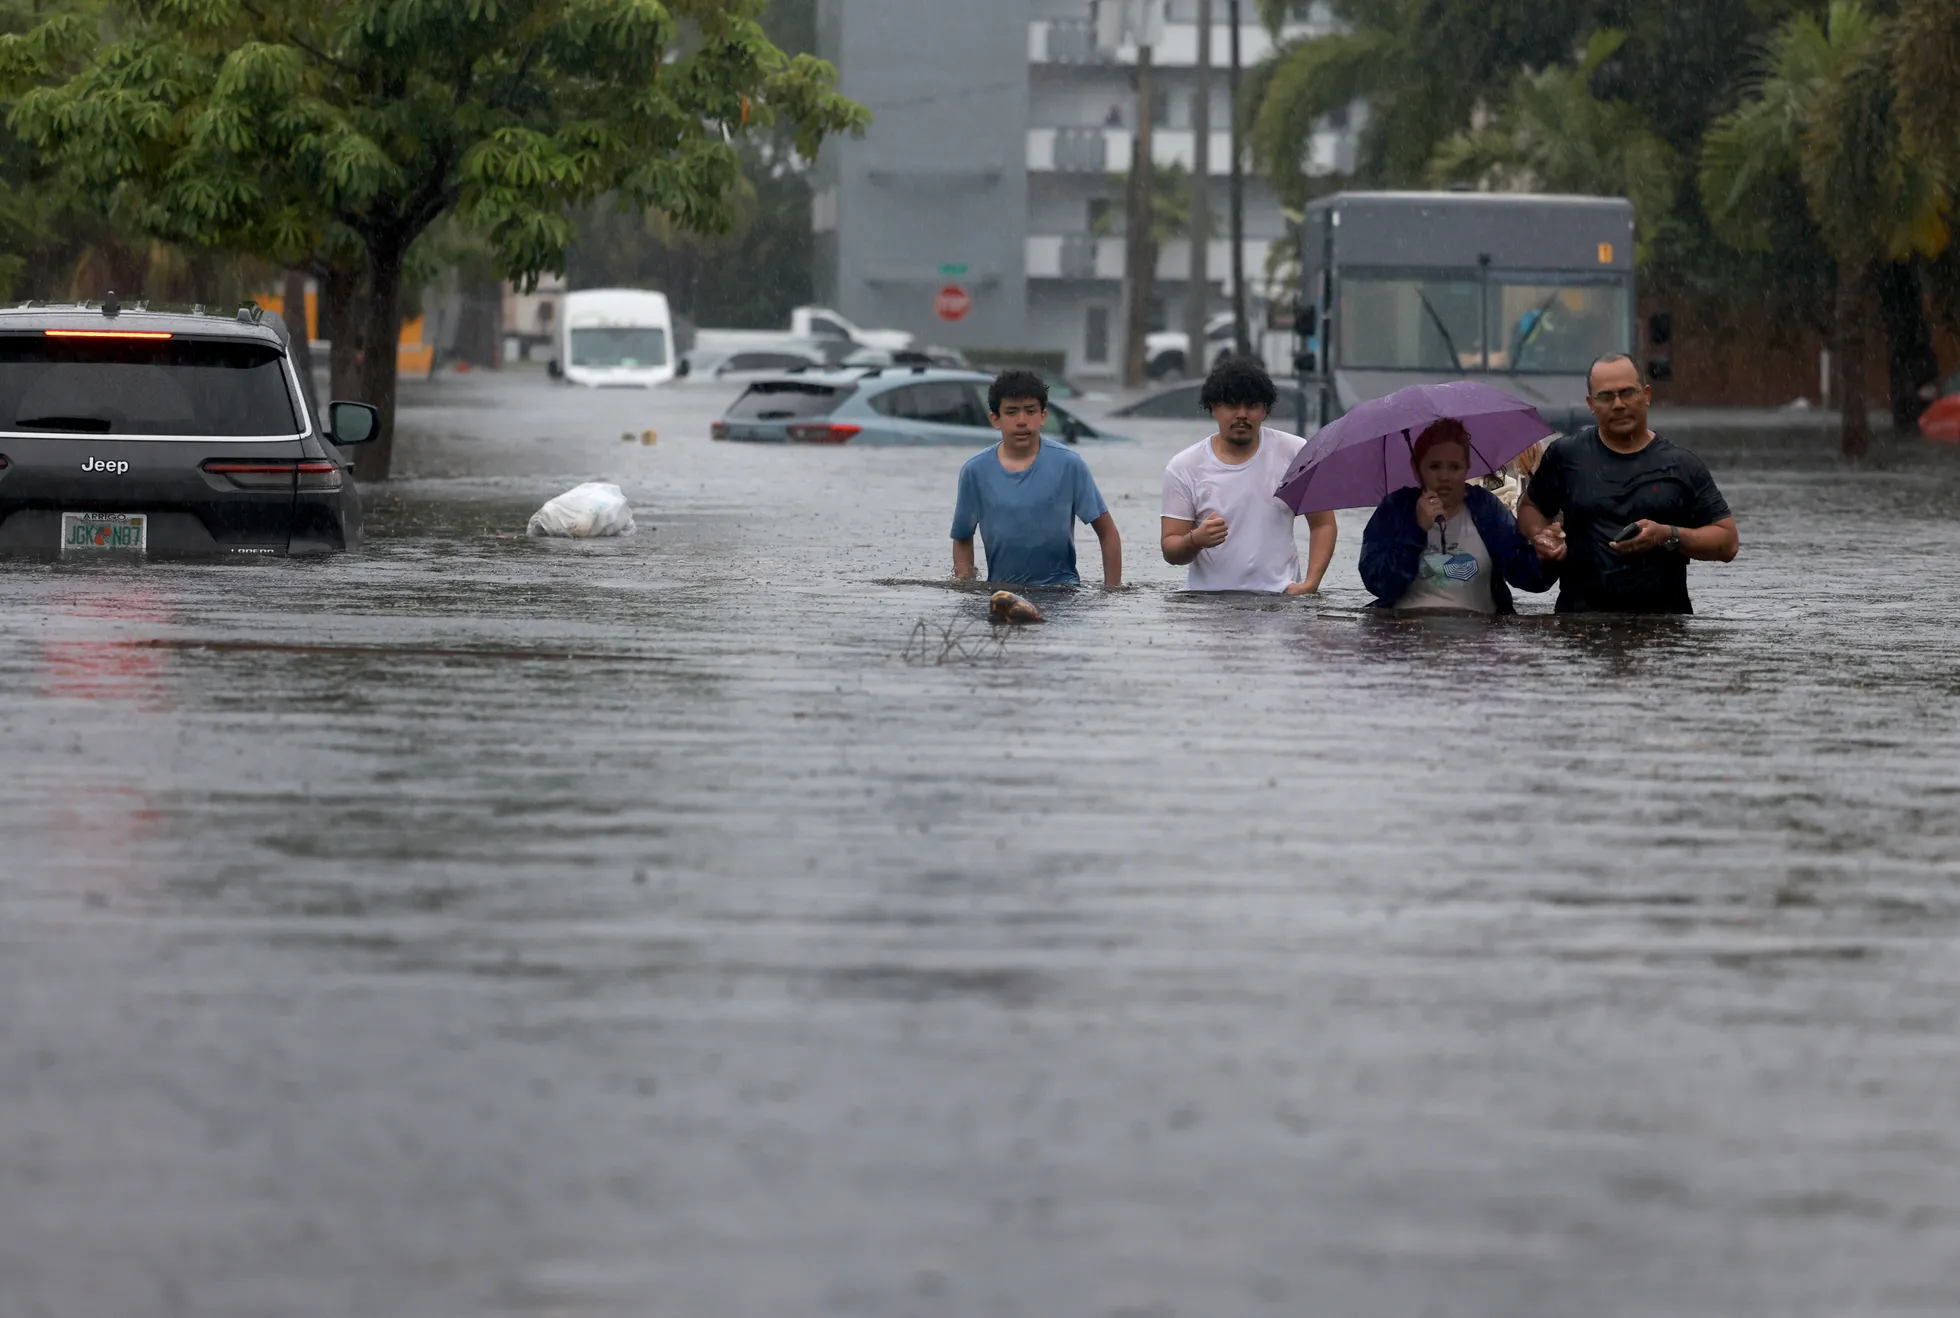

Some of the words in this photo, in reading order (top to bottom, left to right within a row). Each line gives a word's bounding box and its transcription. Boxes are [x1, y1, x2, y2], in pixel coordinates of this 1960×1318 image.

[81, 456, 129, 475] Jeep
[83, 513, 127, 521] ARRIGO
[67, 525, 94, 545] JGK
[112, 526, 141, 545] N87
